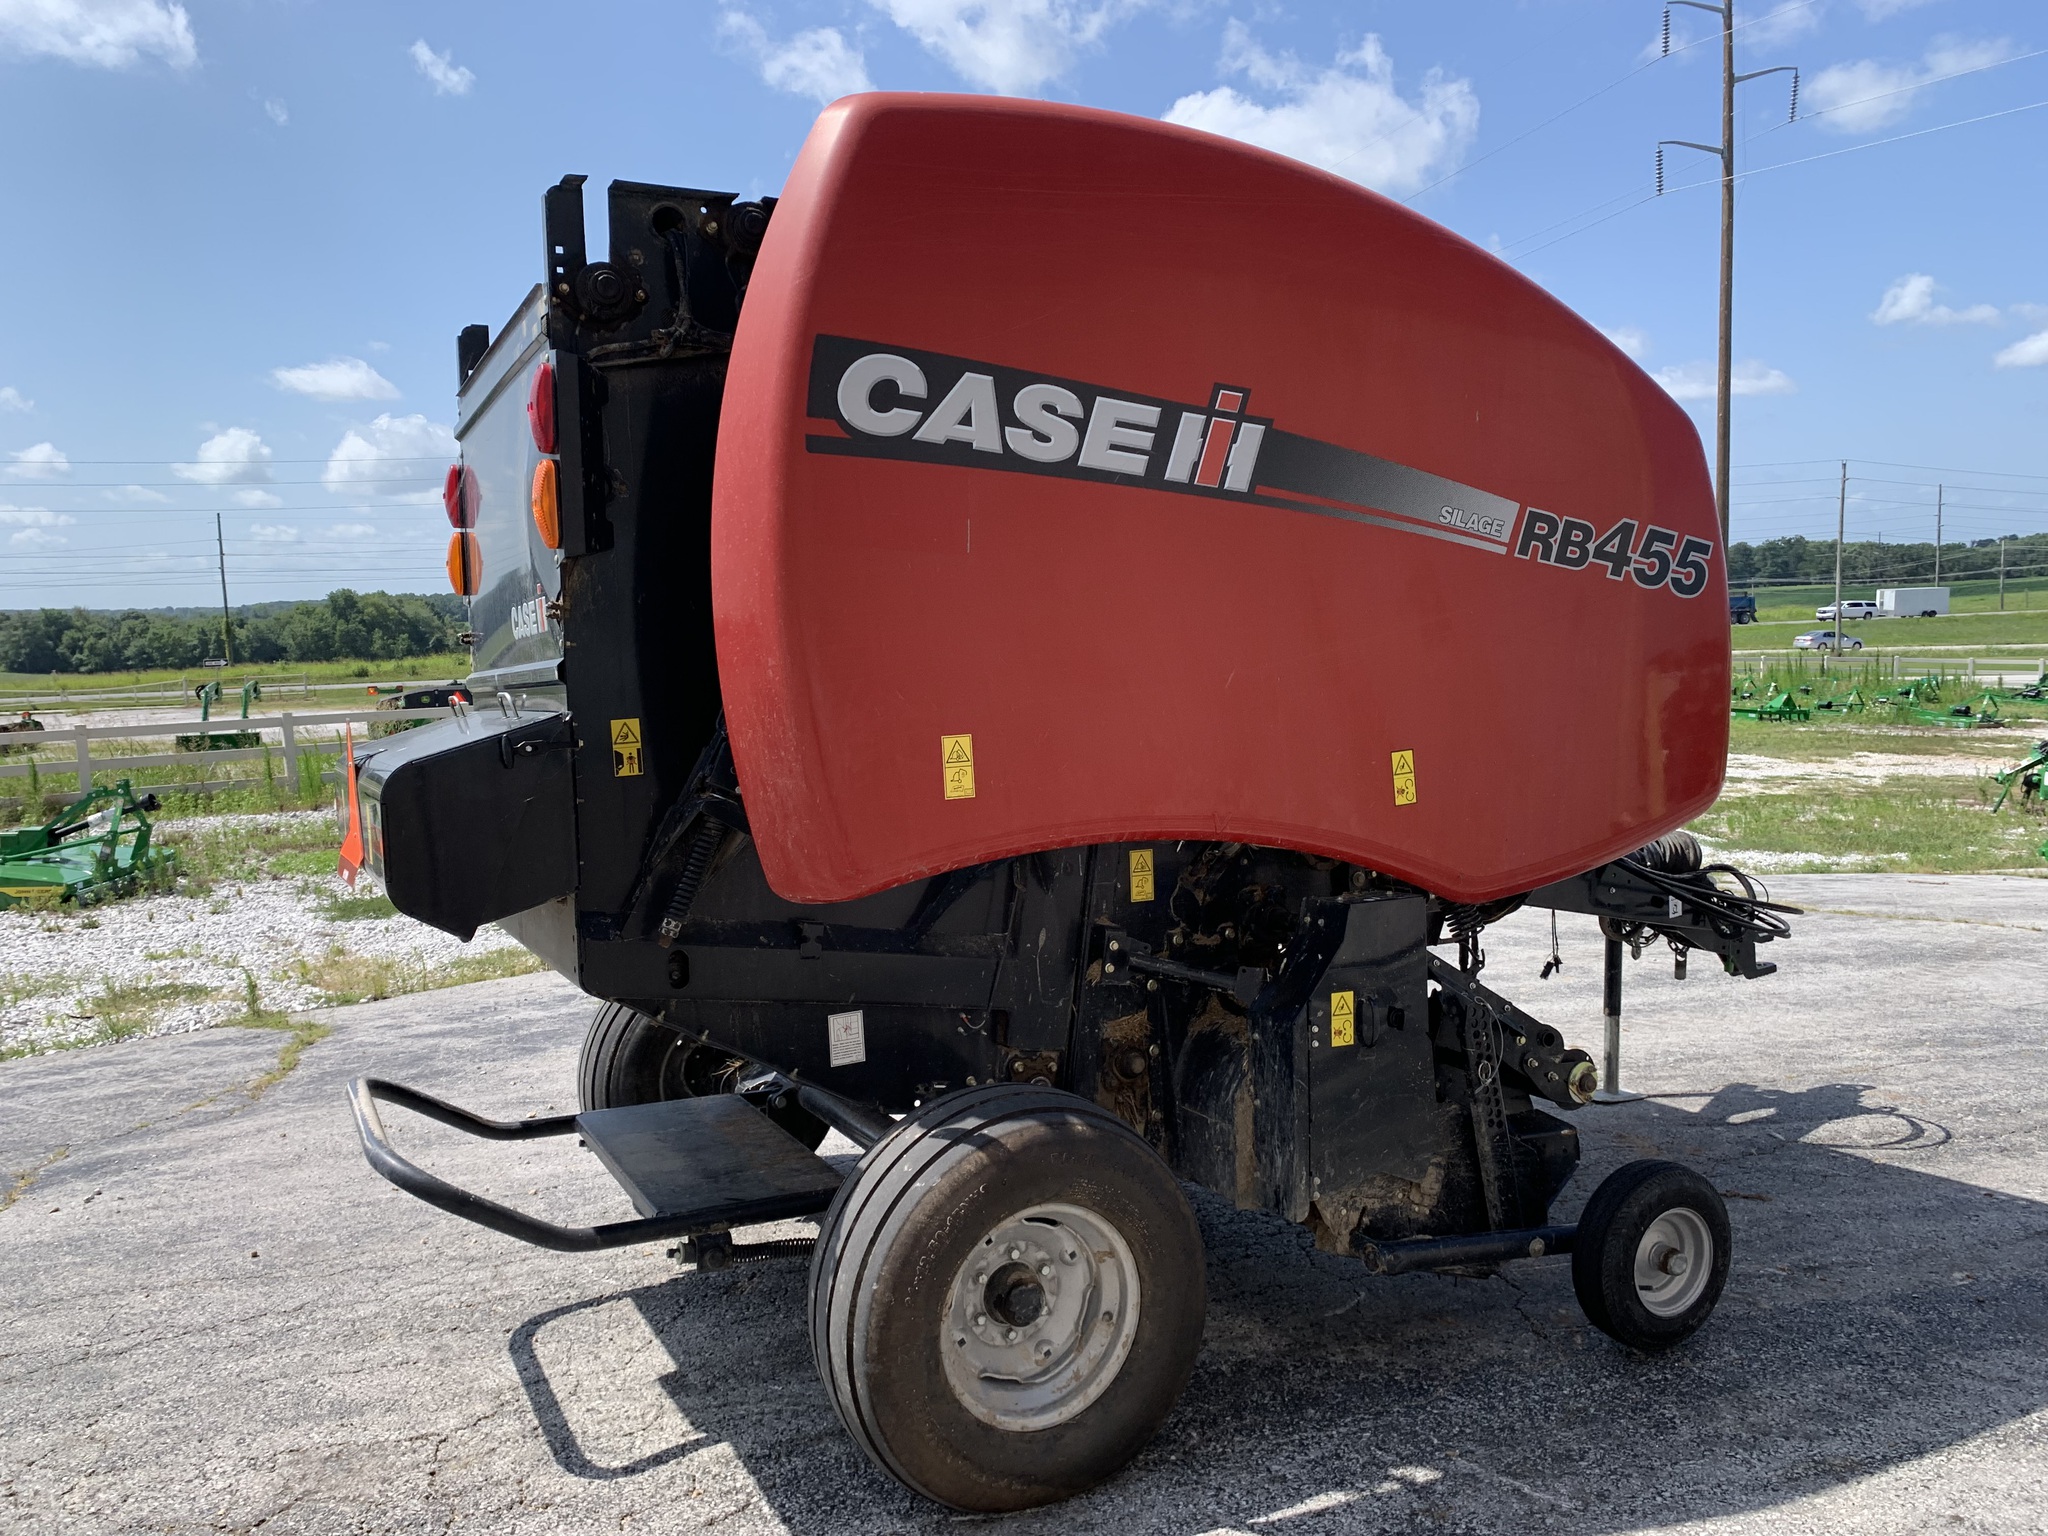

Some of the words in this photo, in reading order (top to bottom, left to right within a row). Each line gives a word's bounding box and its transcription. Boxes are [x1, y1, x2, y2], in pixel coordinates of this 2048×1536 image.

[837, 353, 1162, 477] CASE
[1438, 505, 1506, 538] SILAGE
[1514, 506, 1714, 599] RB455
[511, 600, 538, 640] CASE
